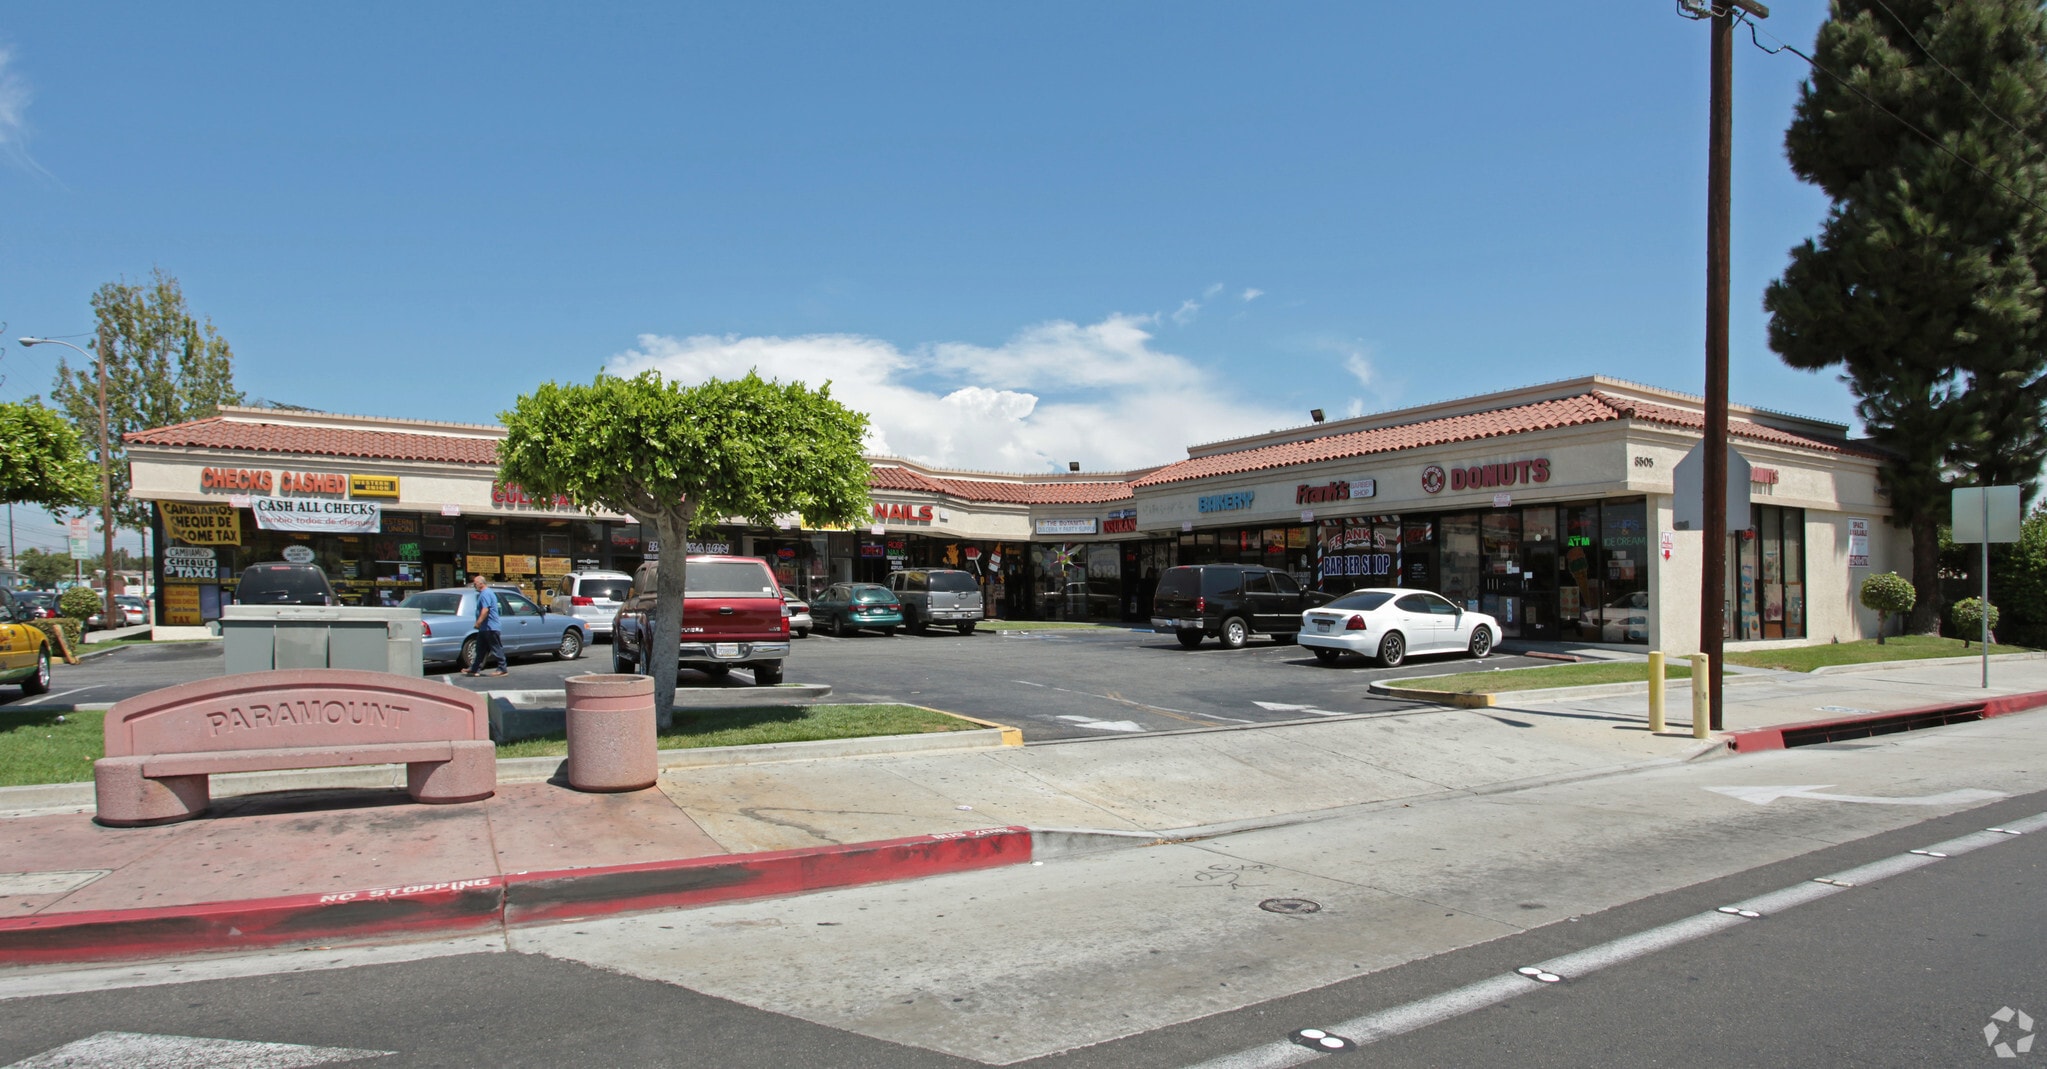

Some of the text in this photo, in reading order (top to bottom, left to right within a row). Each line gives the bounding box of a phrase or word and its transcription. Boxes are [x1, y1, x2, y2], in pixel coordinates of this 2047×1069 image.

[201, 467, 346, 494] CHECKS CASHED
[1351, 481, 1373, 489] BARBER
[1296, 481, 1350, 504] Frank's
[1354, 489, 1370, 497] SHOP
[258, 500, 293, 512] CASH
[298, 501, 321, 513] ALL
[324, 502, 375, 515] CHECKS
[1198, 490, 1255, 513] BAKERY
[163, 503, 234, 515] CAMBIAMOS
[874, 503, 933, 521] NAILS
[170, 515, 232, 528] CHEQUE DE
[260, 516, 375, 527] Cambio todos de cheques
[216, 530, 238, 542] TAX
[1328, 527, 1386, 553] FRANK'S
[1567, 537, 1590, 547] ATM
[1616, 536, 1647, 546] CREAM
[862, 546, 883, 556] OPEN
[887, 541, 905, 549] ROSE
[169, 548, 210, 557] CAMBIAMOS
[168, 558, 214, 566] CHEQUES
[1323, 555, 1361, 576] BARBER
[1361, 554, 1391, 575] SHOP
[175, 566, 218, 578] TAXES
[172, 616, 191, 624] TAX
[206, 700, 410, 738] PARAMOUNT
[319, 878, 491, 903] NO STOPPING
